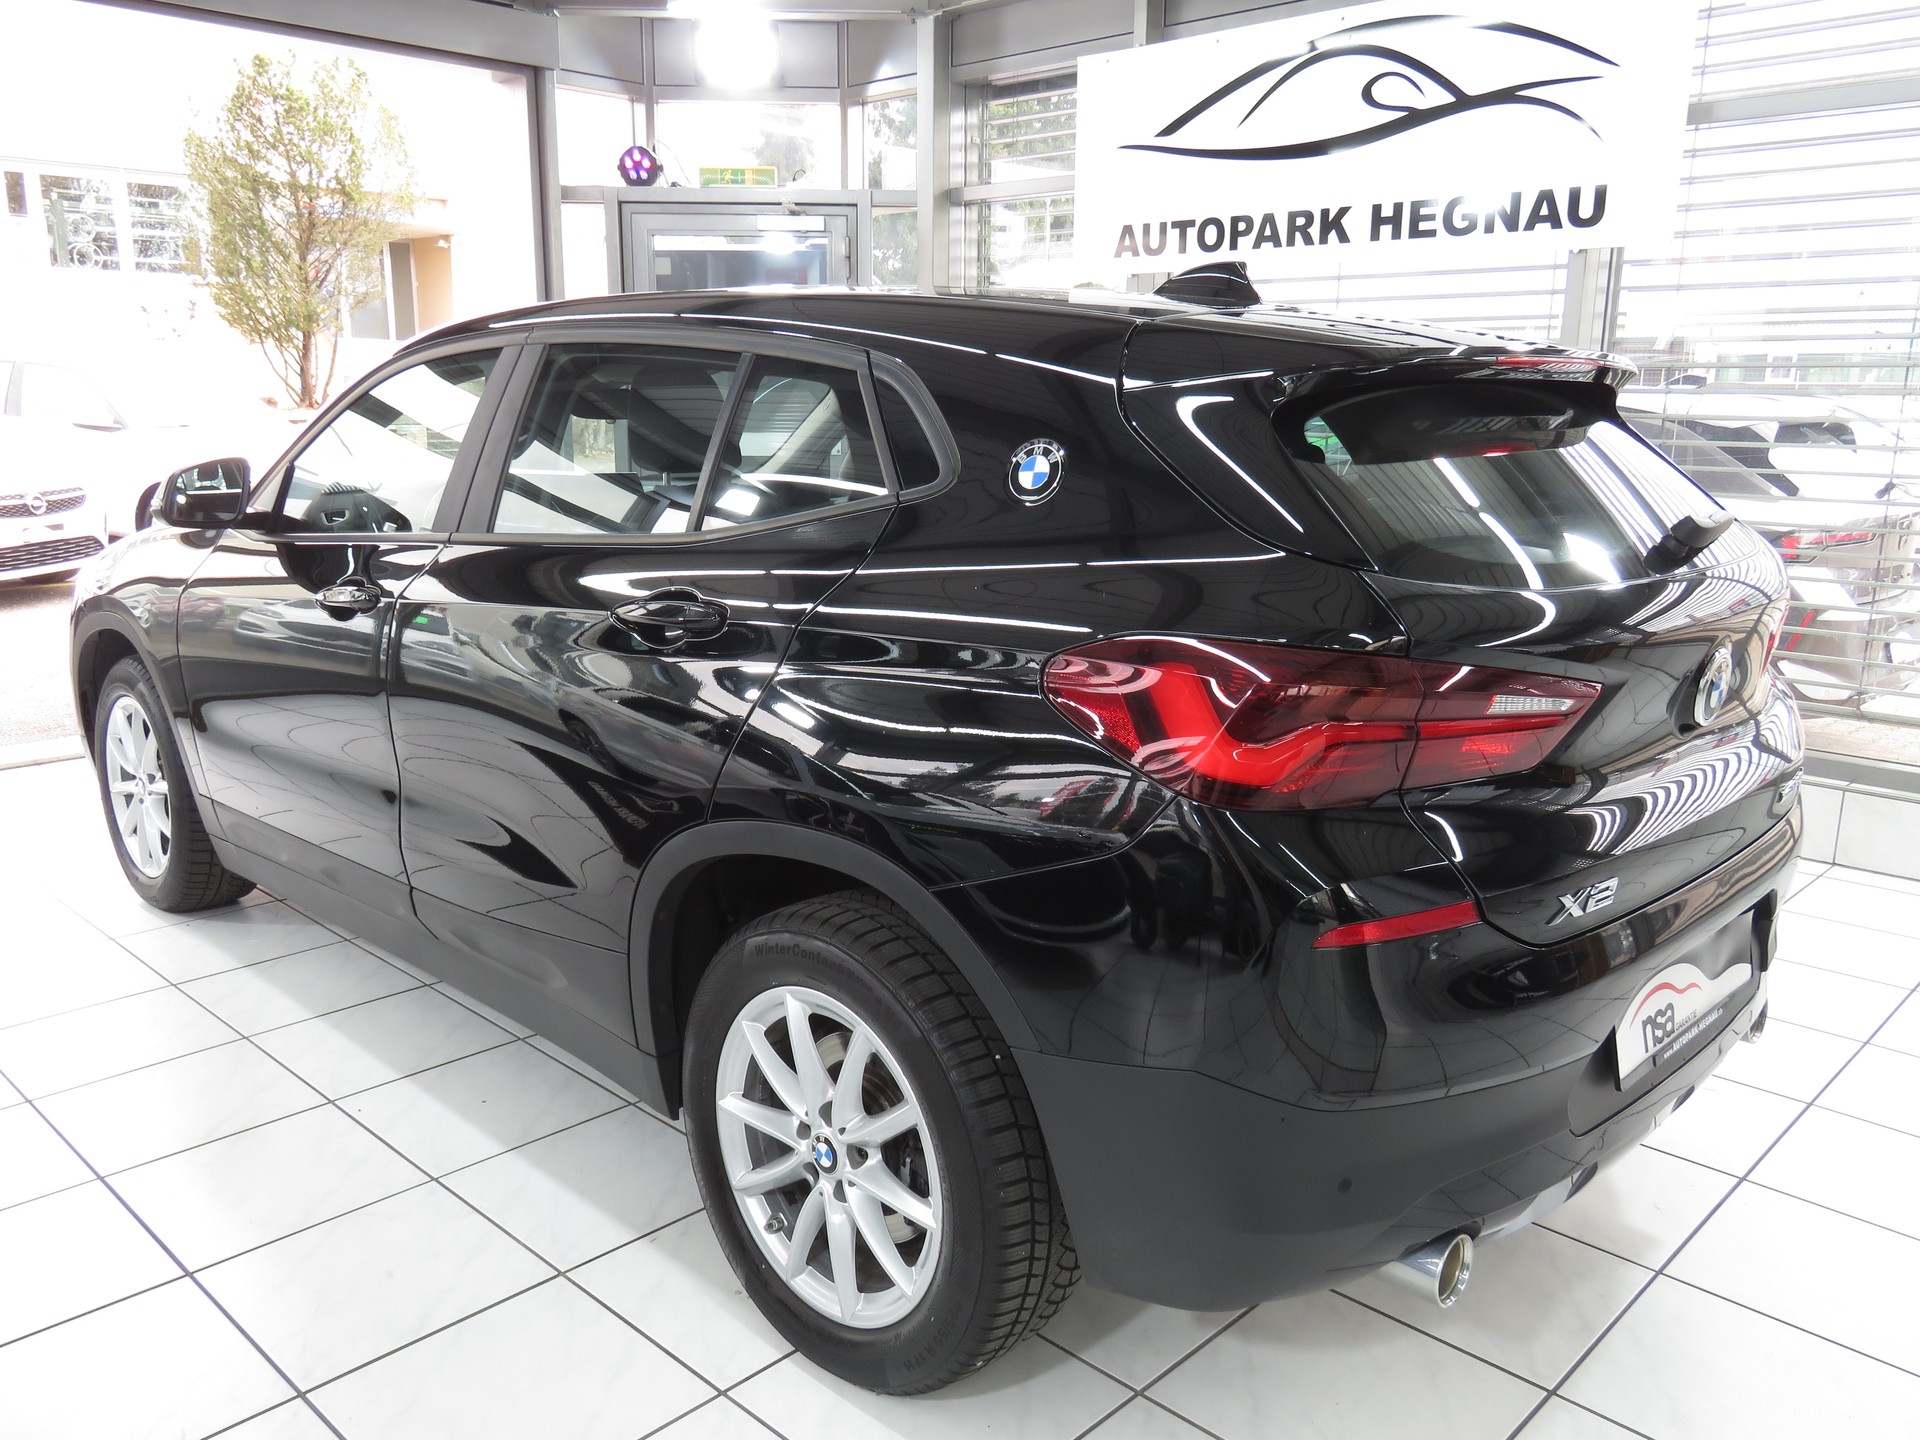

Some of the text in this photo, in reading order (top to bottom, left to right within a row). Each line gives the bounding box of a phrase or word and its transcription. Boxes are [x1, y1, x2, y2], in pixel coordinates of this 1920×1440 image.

[1114, 184, 1608, 258] AUTOPARK HEGNAU
[1547, 877, 1619, 927] X2
[1641, 1002, 1676, 1054] nsa
